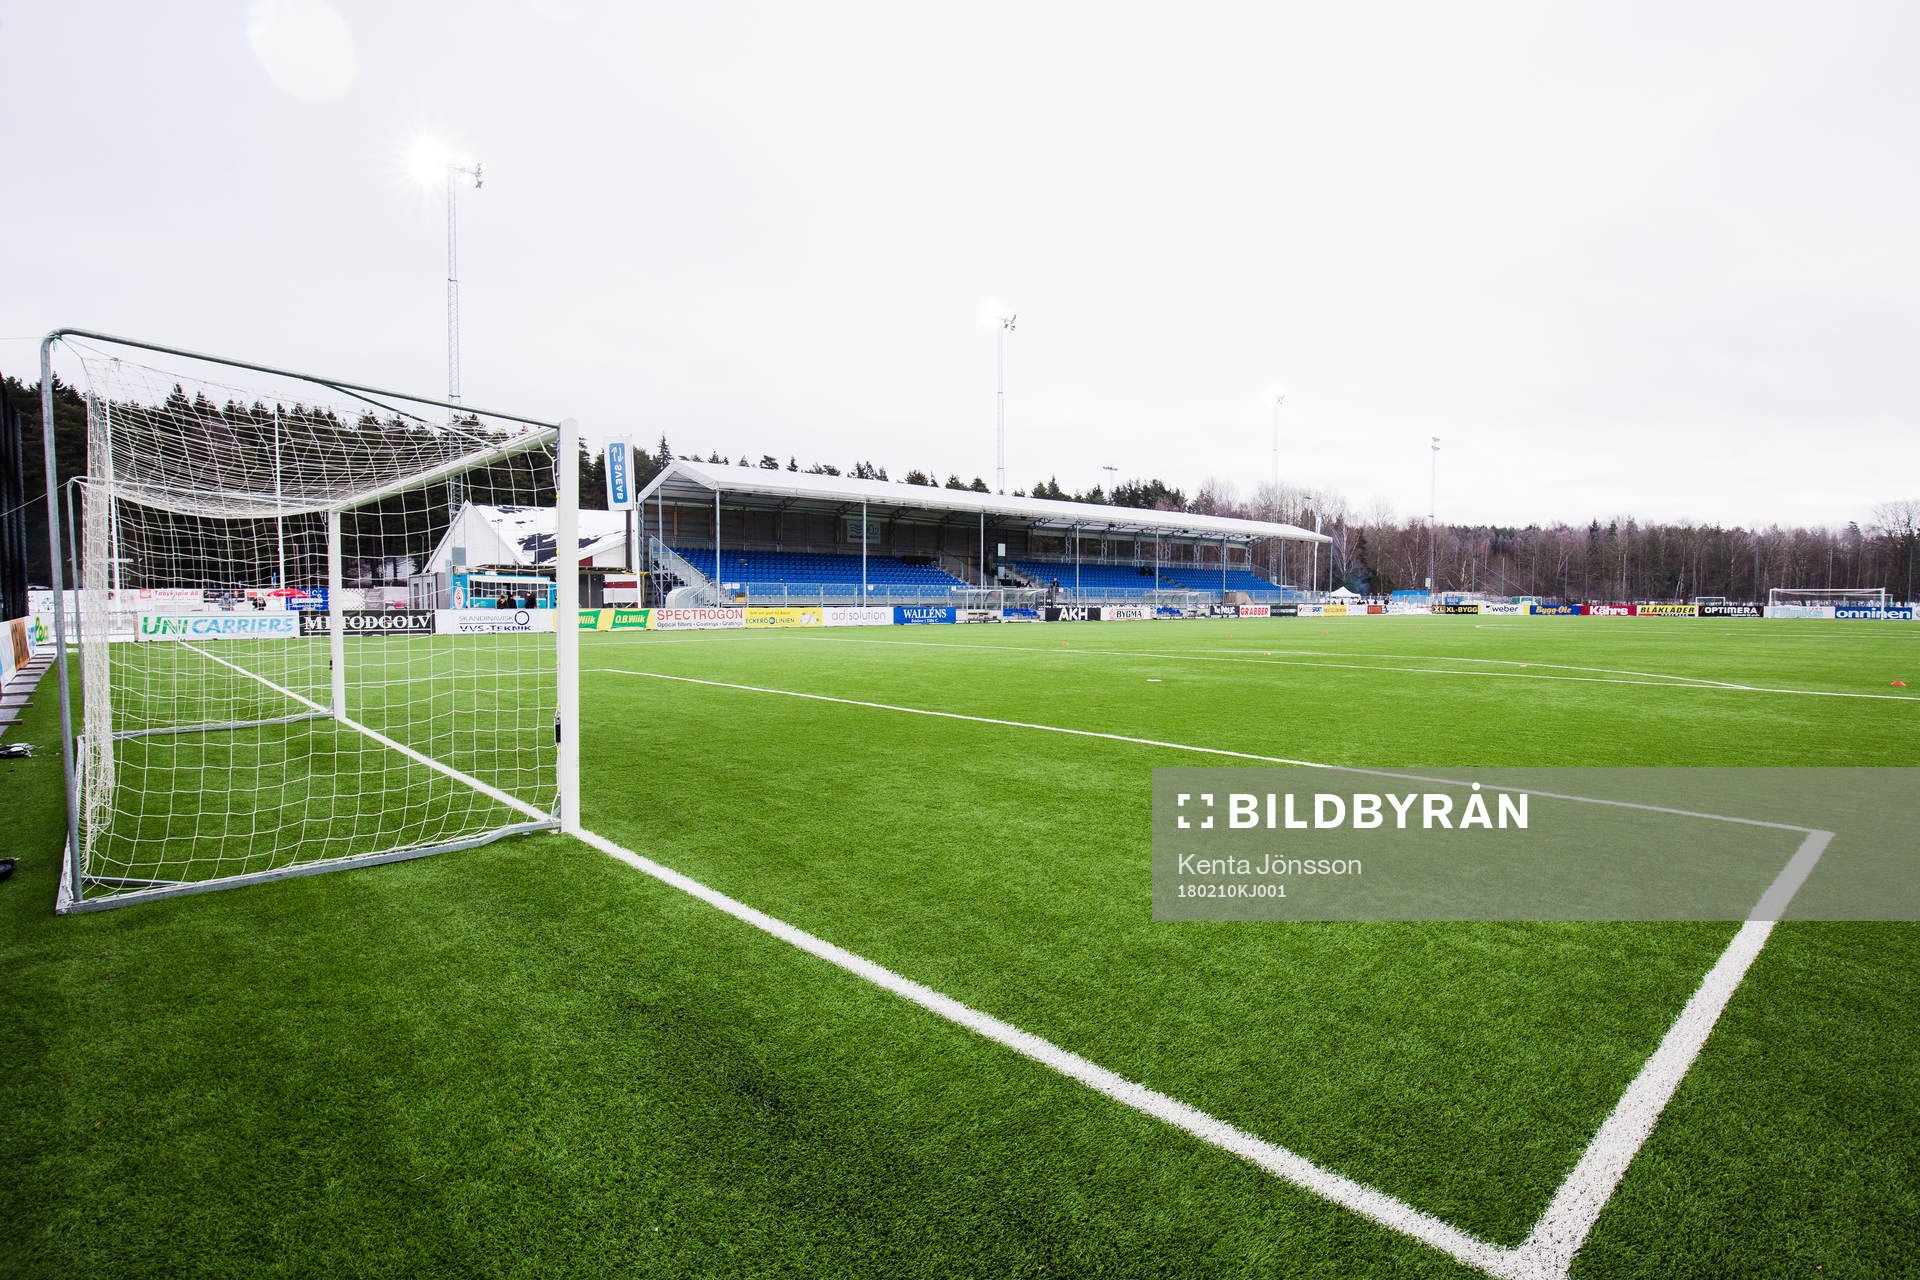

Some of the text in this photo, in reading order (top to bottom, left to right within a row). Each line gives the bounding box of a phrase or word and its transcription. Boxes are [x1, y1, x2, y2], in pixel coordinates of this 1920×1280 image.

[903, 606, 947, 619] WALLÉNS
[1058, 607, 1089, 621] AKH
[1116, 610, 1143, 618] BYGMA
[1240, 607, 1269, 616] GRABBER
[1446, 605, 1478, 613] XL-BYGG
[1492, 605, 1518, 613] weber
[1589, 605, 1629, 615] Kährs
[1704, 606, 1758, 614] OPTIMERA
[1836, 607, 1911, 619] onninen
[656, 608, 744, 621] SPECTROGON
[142, 616, 294, 635] UNI CARRIERS
